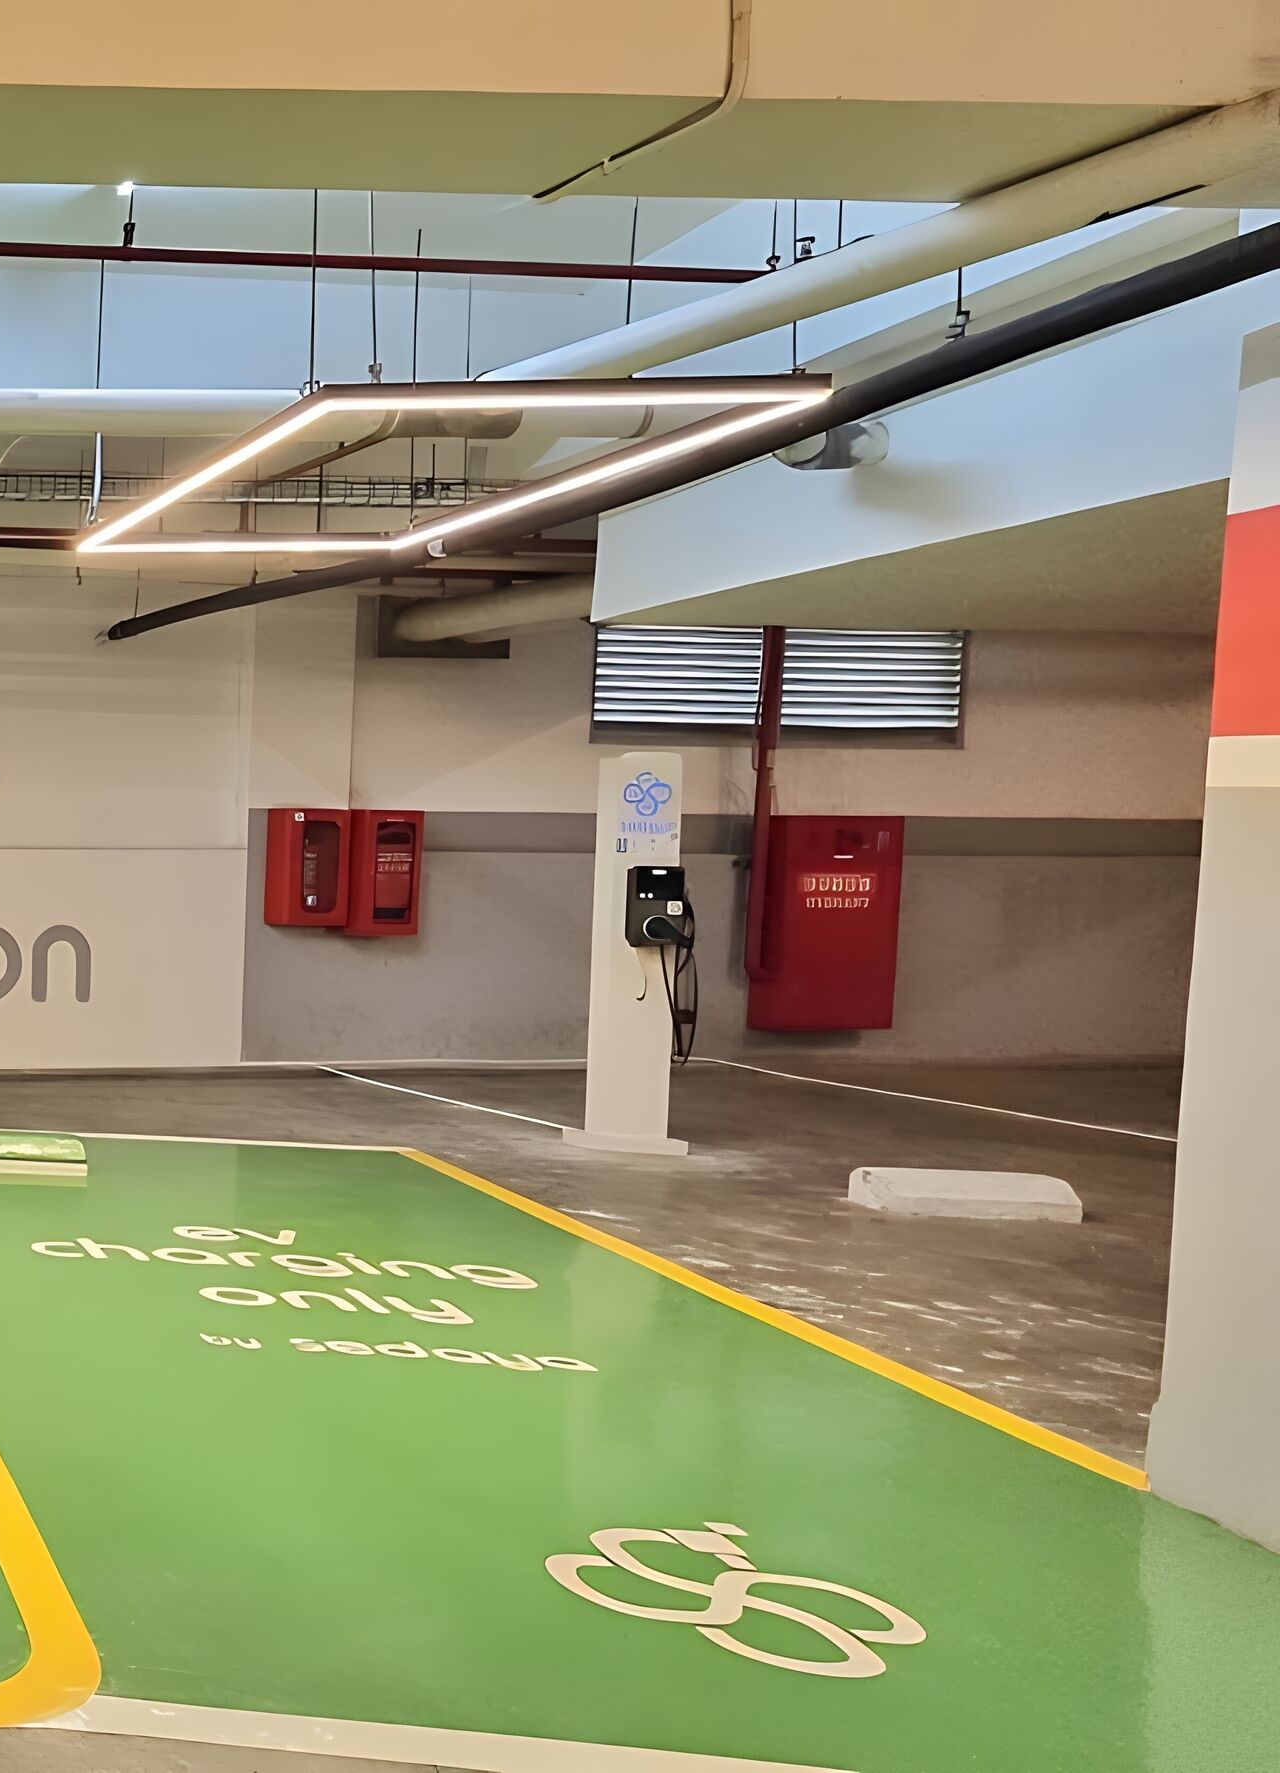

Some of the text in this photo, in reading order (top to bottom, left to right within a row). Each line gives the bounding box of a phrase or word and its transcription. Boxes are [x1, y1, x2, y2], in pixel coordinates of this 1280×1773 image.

[172, 1225, 298, 1246] ev
[29, 1237, 539, 1290] charging
[198, 1286, 474, 1325] only
[288, 1337, 599, 1372] sedaya
